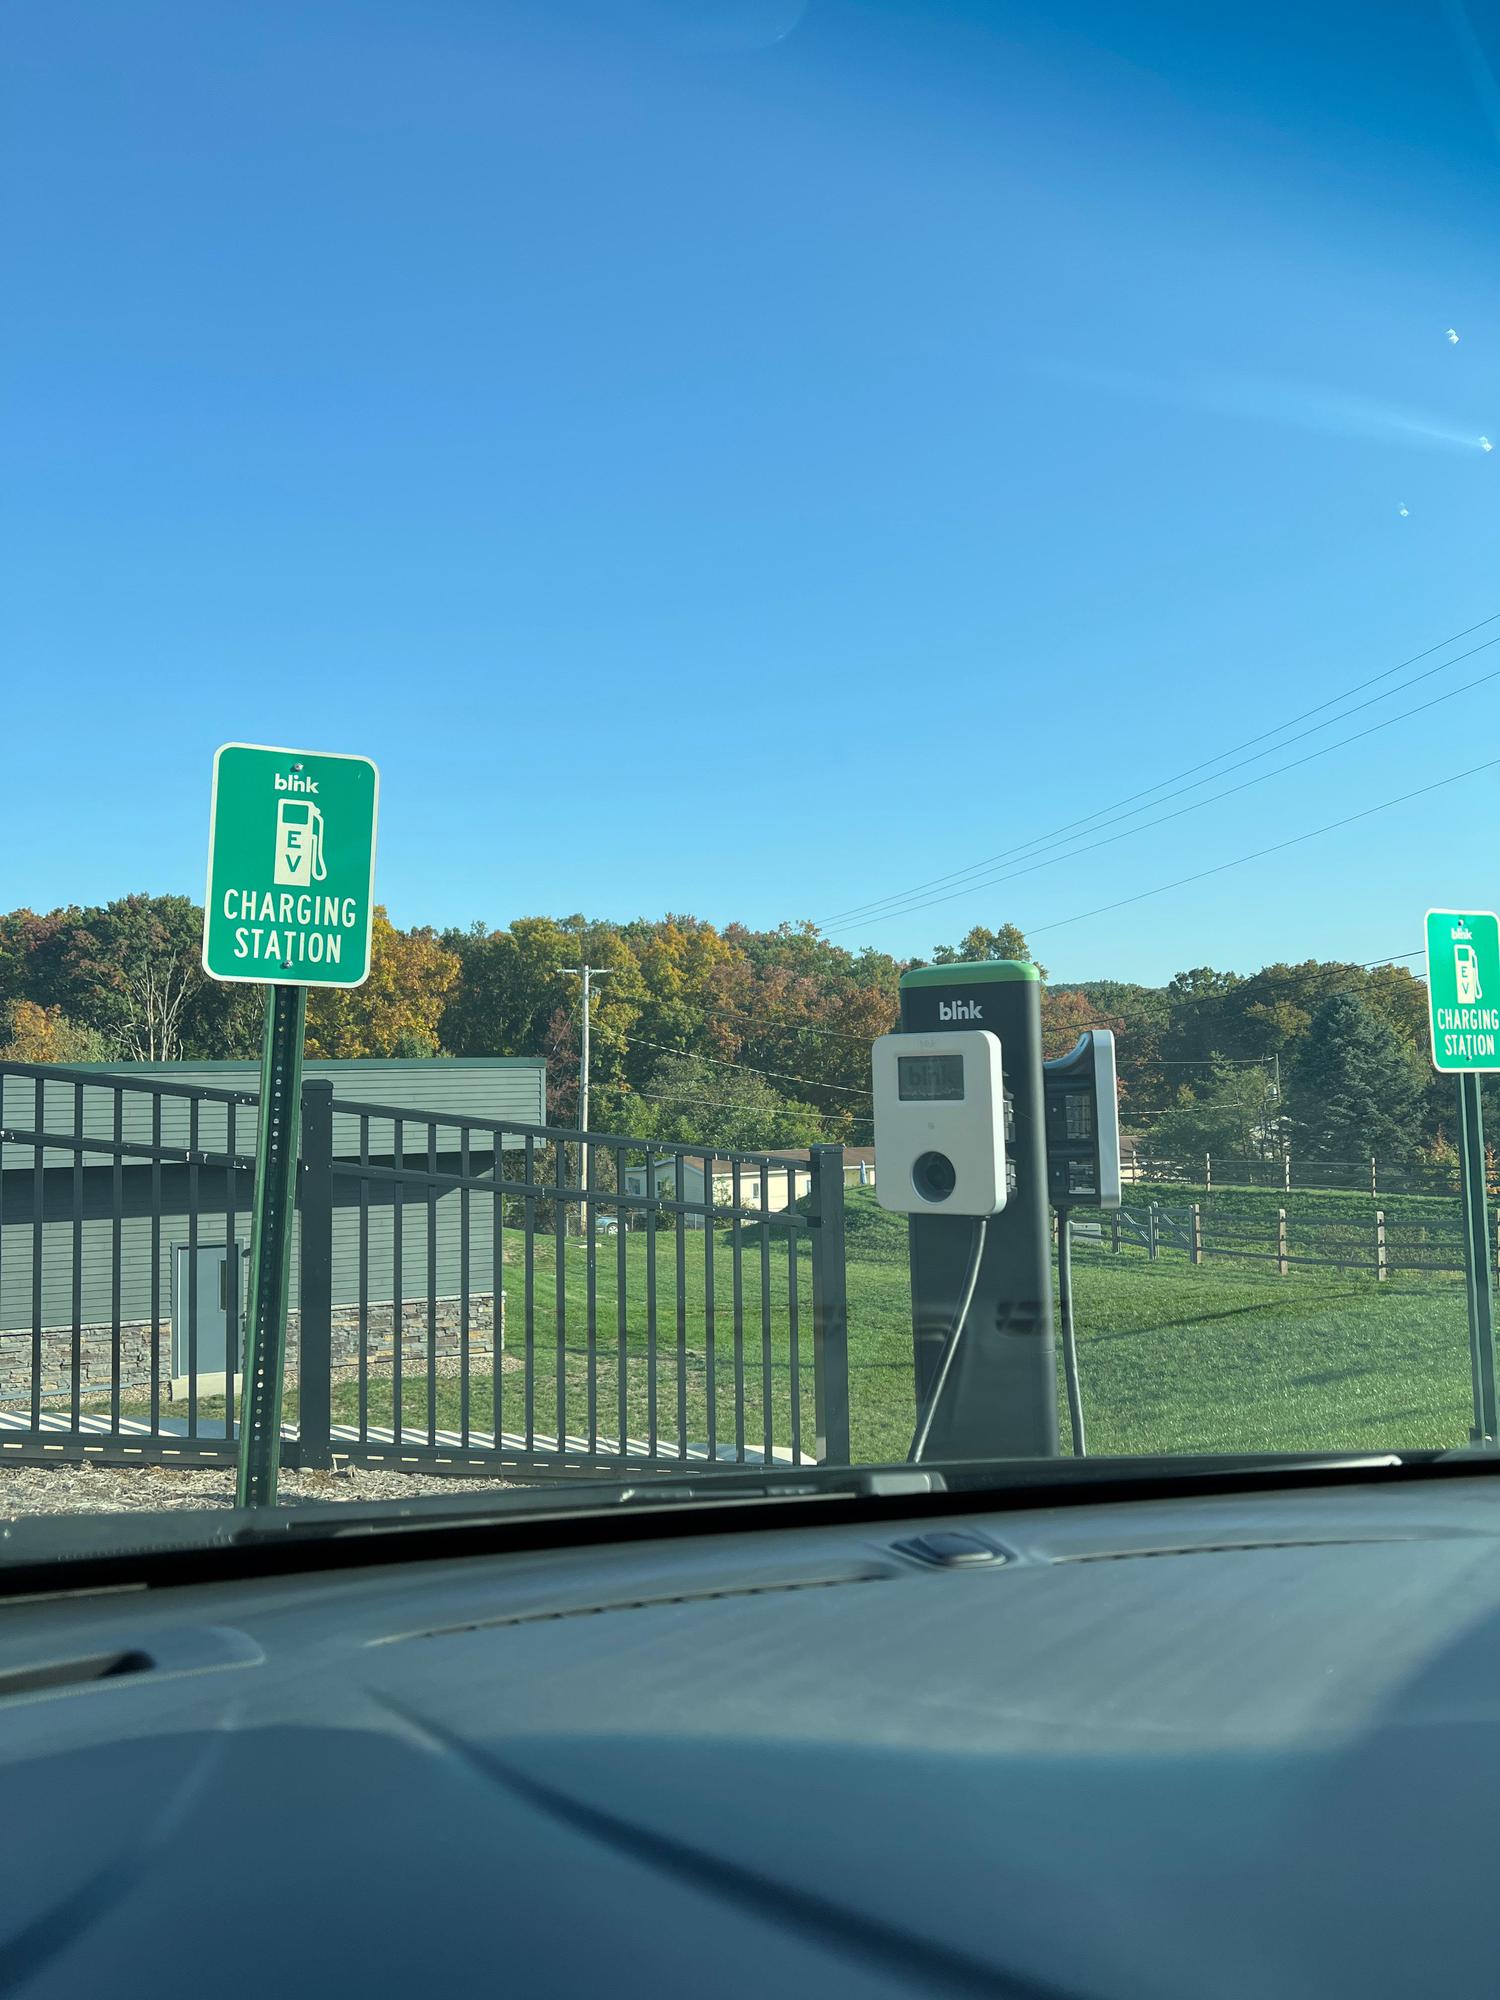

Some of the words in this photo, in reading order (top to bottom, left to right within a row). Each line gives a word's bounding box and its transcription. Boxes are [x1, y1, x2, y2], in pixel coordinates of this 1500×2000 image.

[274, 773, 319, 794] blink
[223, 888, 357, 928] CHARGING
[1451, 928, 1473, 940] blink
[233, 927, 342, 964] STATION
[939, 1000, 983, 1021] blink
[1437, 1008, 1500, 1031] CHARGING
[1444, 1034, 1496, 1056] STATION
